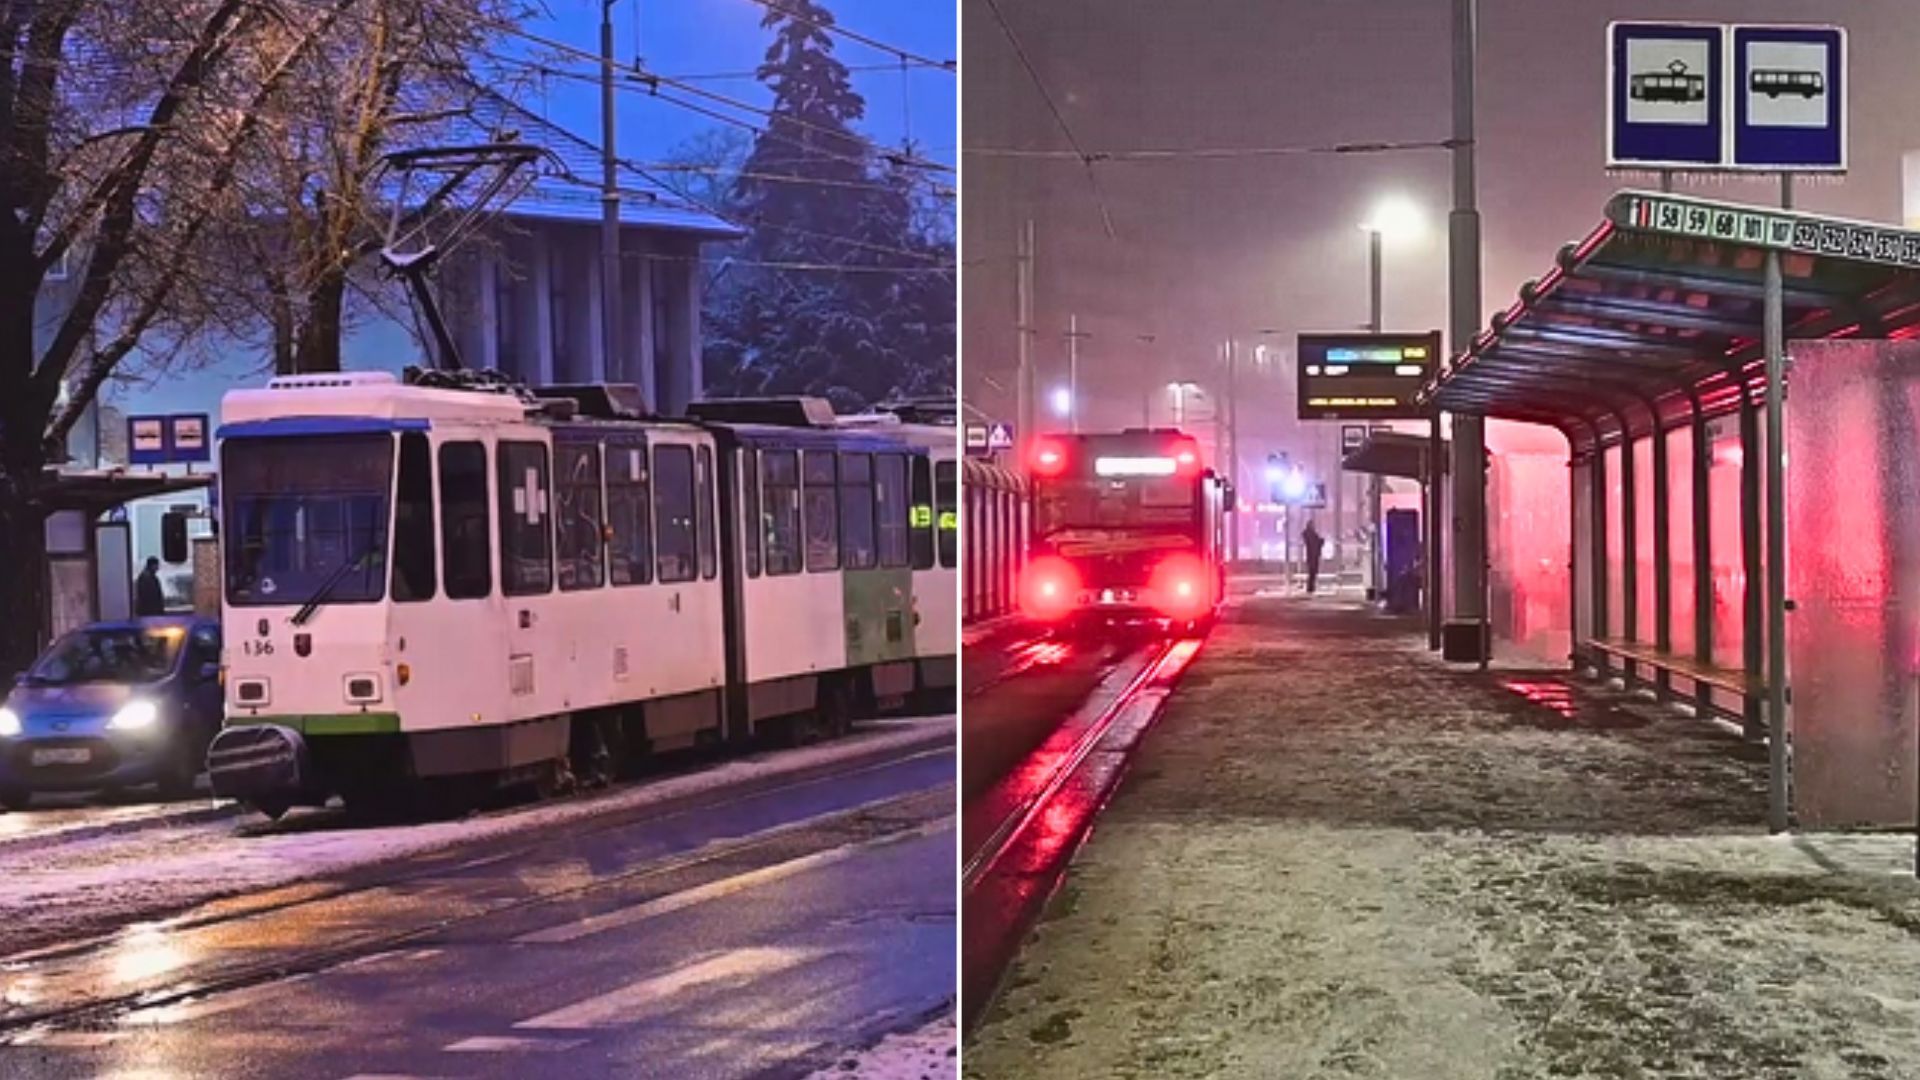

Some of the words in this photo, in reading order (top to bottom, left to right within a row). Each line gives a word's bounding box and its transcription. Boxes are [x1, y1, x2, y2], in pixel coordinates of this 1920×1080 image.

[1660, 203, 1679, 228] 58
[1688, 207, 1707, 231] 59
[1716, 212, 1735, 236] 68
[1744, 216, 1762, 239] 101
[243, 639, 275, 656] 136
